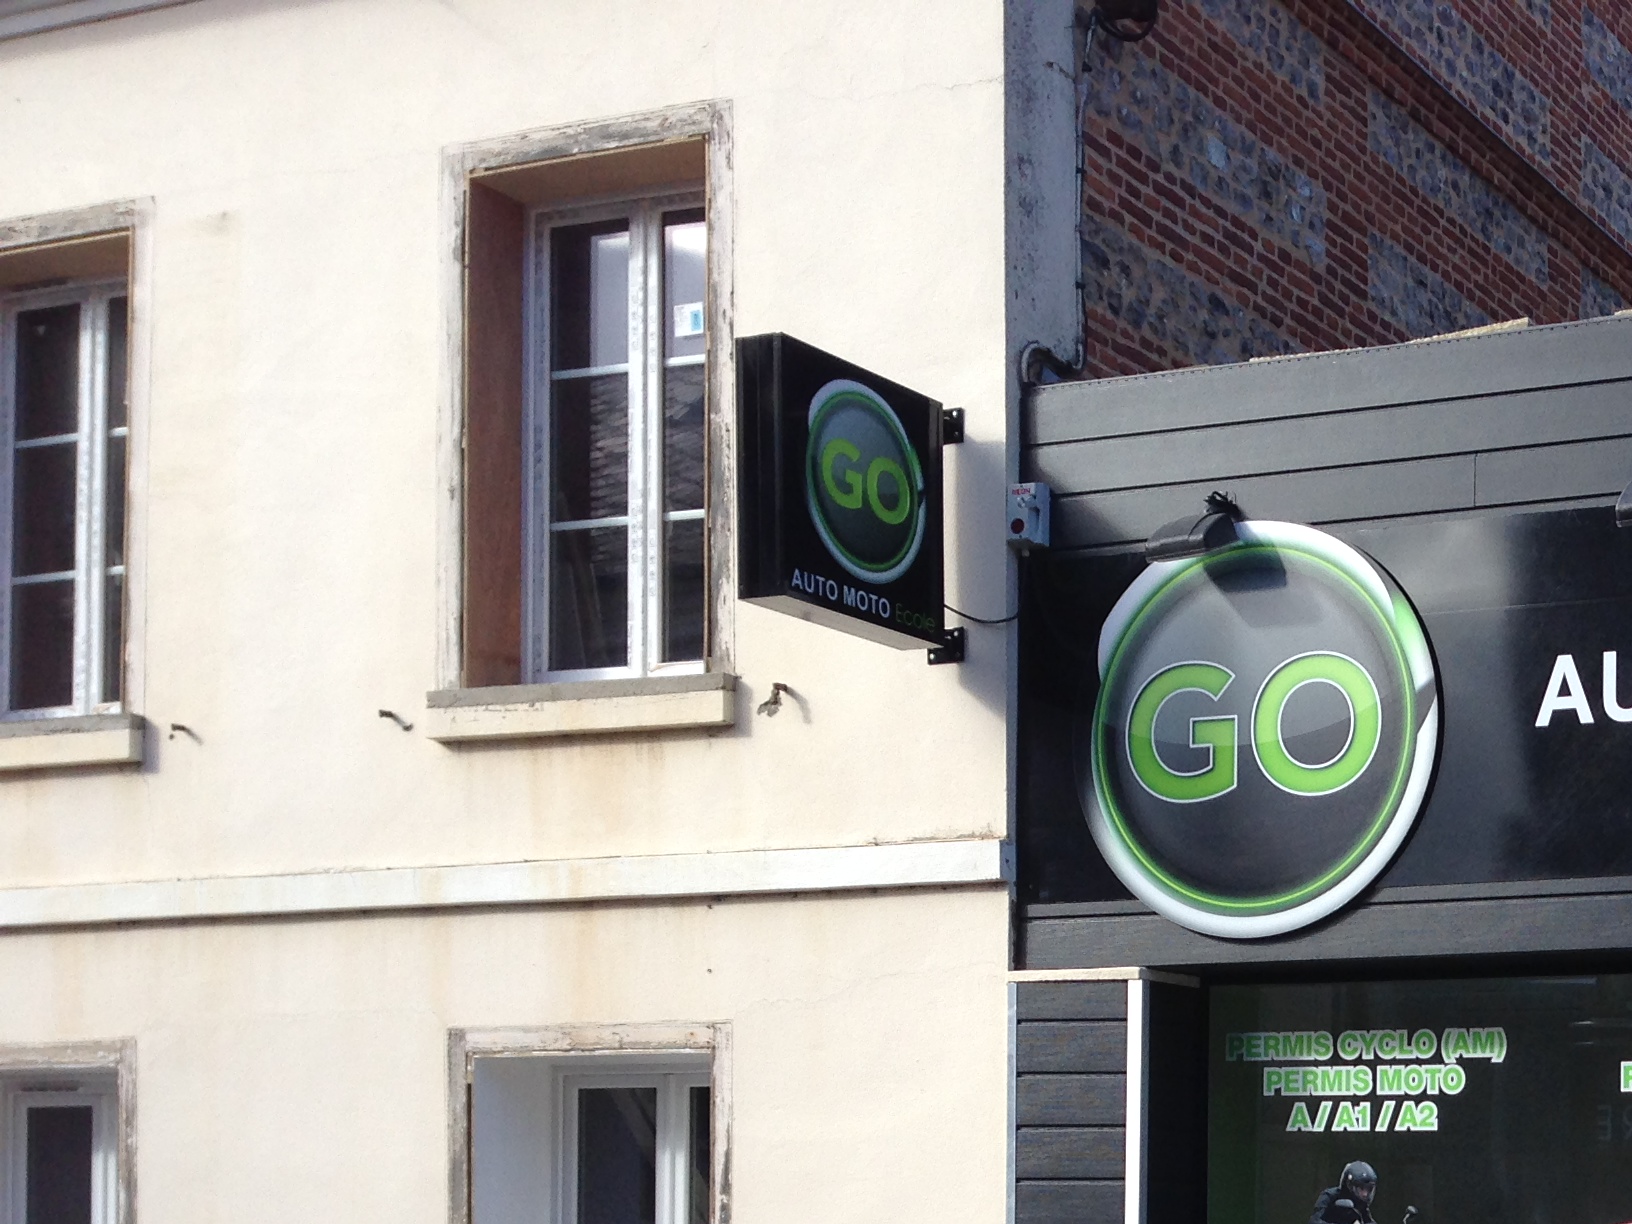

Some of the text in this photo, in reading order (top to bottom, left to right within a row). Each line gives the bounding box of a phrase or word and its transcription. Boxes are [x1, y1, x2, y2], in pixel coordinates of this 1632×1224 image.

[821, 437, 909, 525] GO
[791, 568, 936, 633] AUTO MOTO Ecole
[1125, 650, 1382, 804] GO
[1226, 1027, 1508, 1063] PERMIS CYCLO (AM)
[1263, 1063, 1466, 1096] PERMIS MOTO
